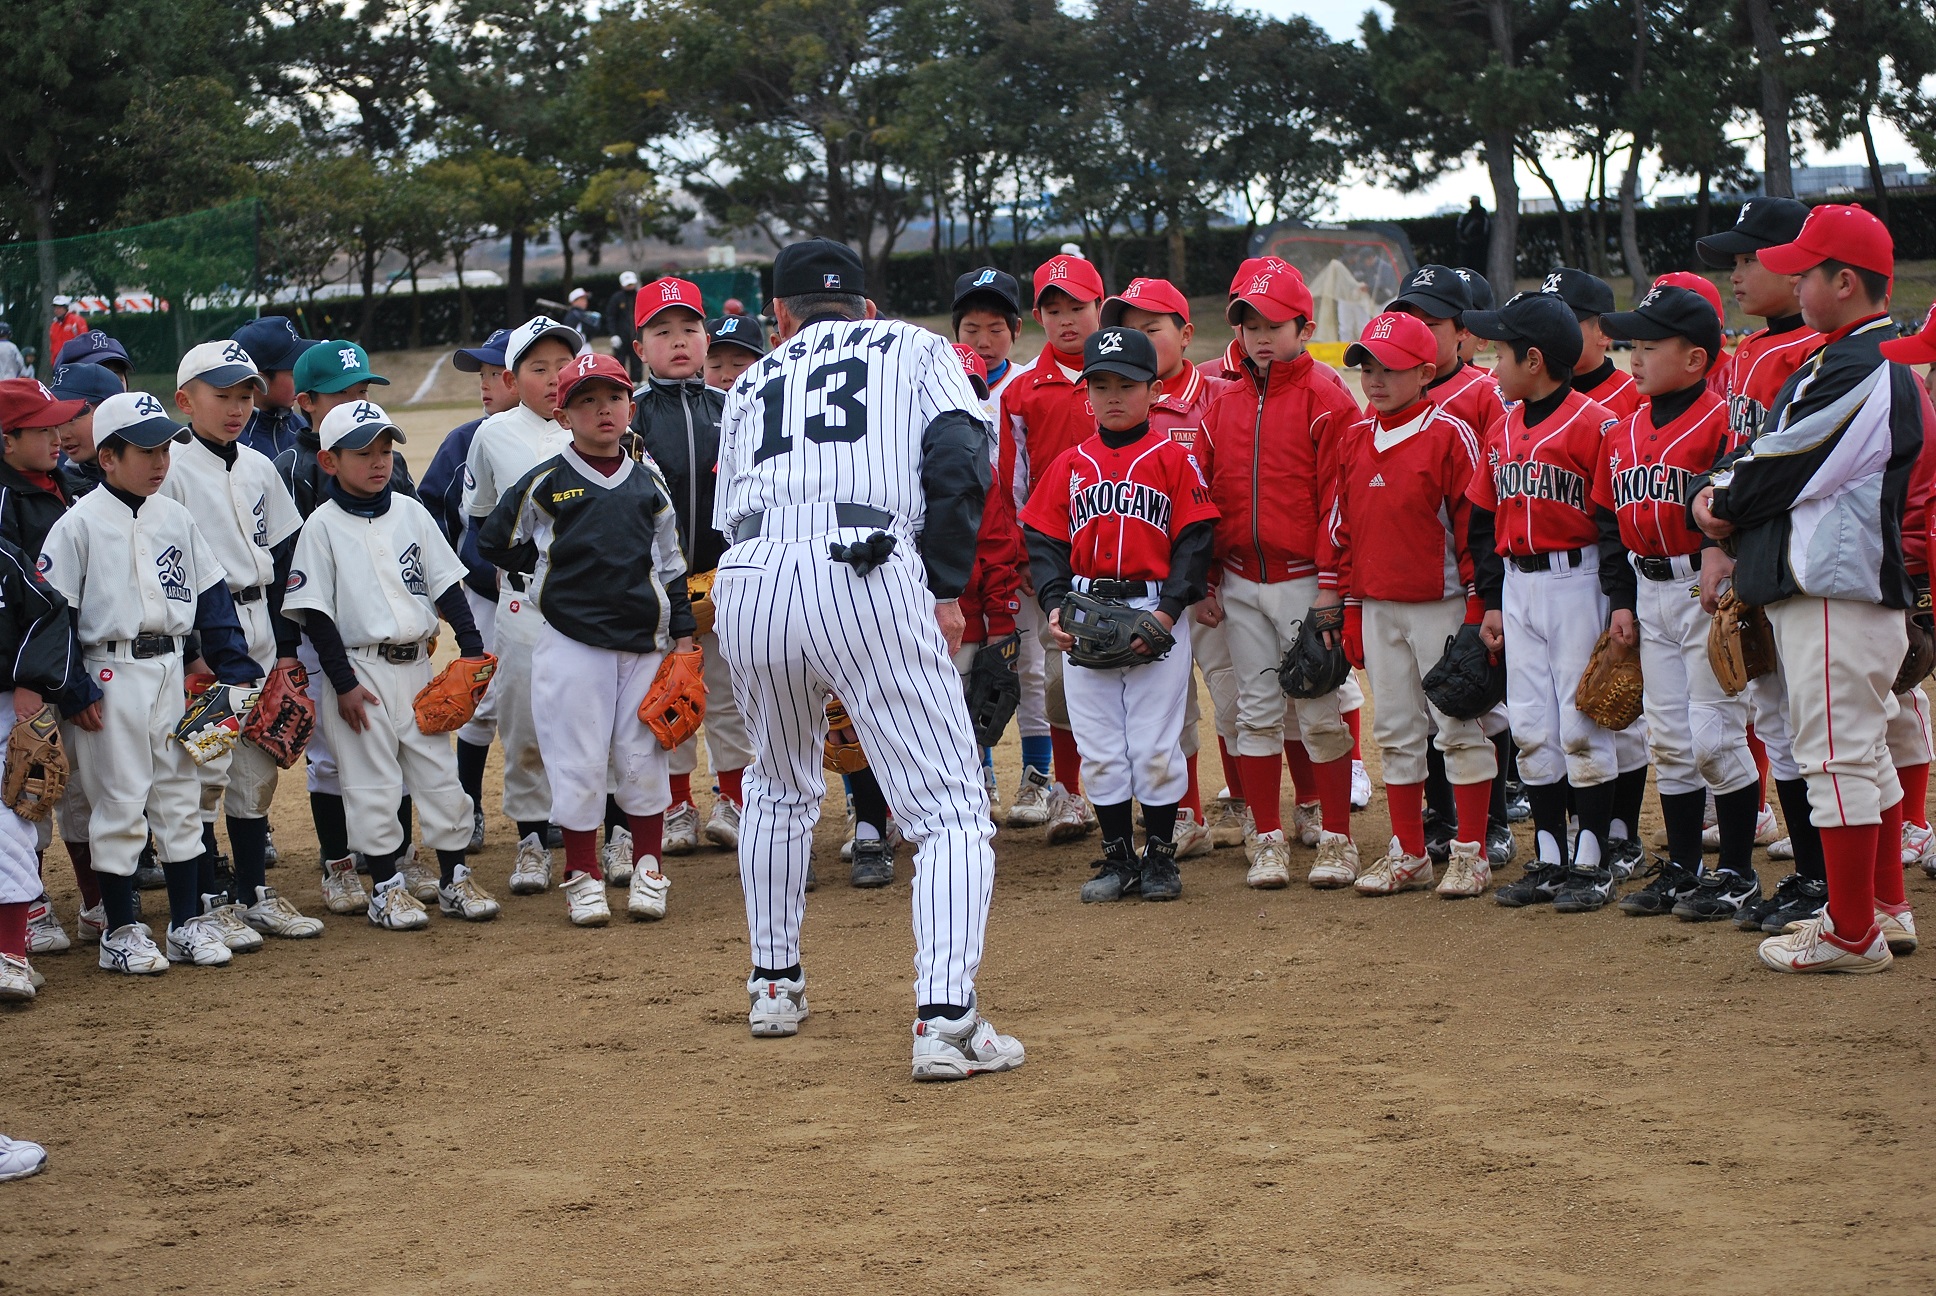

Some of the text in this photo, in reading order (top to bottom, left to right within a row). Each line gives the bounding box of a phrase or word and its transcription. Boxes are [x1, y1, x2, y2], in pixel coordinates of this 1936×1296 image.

[754, 357, 868, 466] 13
[552, 488, 585, 503] ZETT
[1495, 460, 1587, 514] KOGAWA
